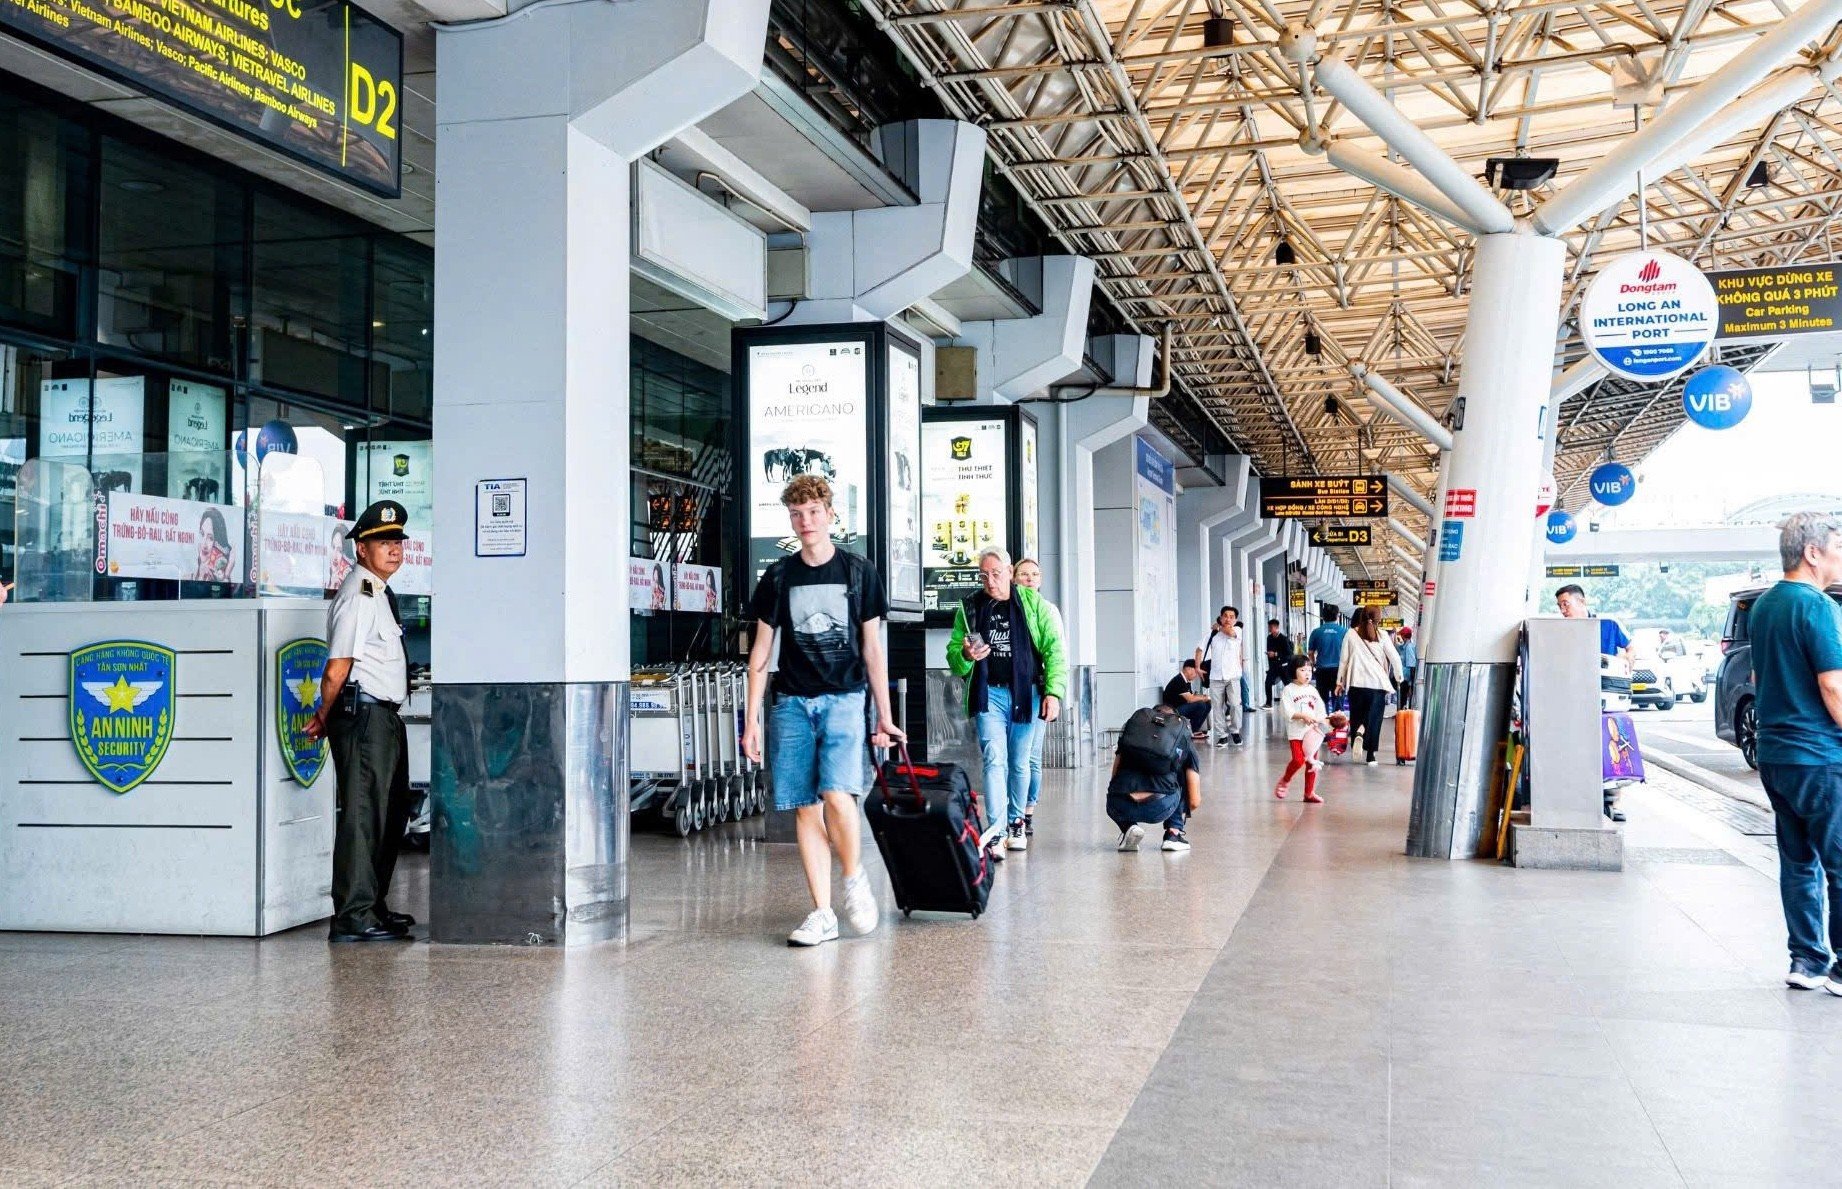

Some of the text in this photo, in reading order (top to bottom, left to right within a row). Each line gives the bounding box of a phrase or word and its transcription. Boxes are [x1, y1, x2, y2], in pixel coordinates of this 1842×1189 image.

[27, 0, 69, 28] Airlines
[161, 0, 306, 81] VIETNAM AIRLINES; VASCO
[71, 0, 318, 129] Vietnam Airlines; Vasco; Pacific Airlines; Bamboo Airways
[113, 0, 335, 116] BAMBOO AIRWAYS; VIETRAVEL AIRLINES
[351, 62, 397, 140] D2
[1718, 270, 1834, 289] KHU VỰC DỪNG XE
[1619, 282, 1677, 294] Dongtam
[1715, 284, 1839, 305] KHÔNG QUÁ 3 PHÚT
[1618, 300, 1681, 312] LONG AN
[1745, 304, 1810, 317] Car Parking
[1593, 312, 1708, 328] INTERNATIONAL
[1724, 317, 1833, 333] Maximum 3 Minutes
[1632, 328, 1670, 339] PORT
[789, 382, 828, 395] Legend
[764, 402, 854, 417] AMERICANO
[1688, 393, 1732, 412] VIB
[1314, 480, 1326, 488] XE
[1593, 481, 1622, 494] VIB
[161, 509, 179, 527] CÙNG
[1349, 530, 1368, 542] D3
[1546, 525, 1567, 535] VIB
[91, 716, 153, 738] AN NINH
[98, 741, 146, 756] SECURITY
